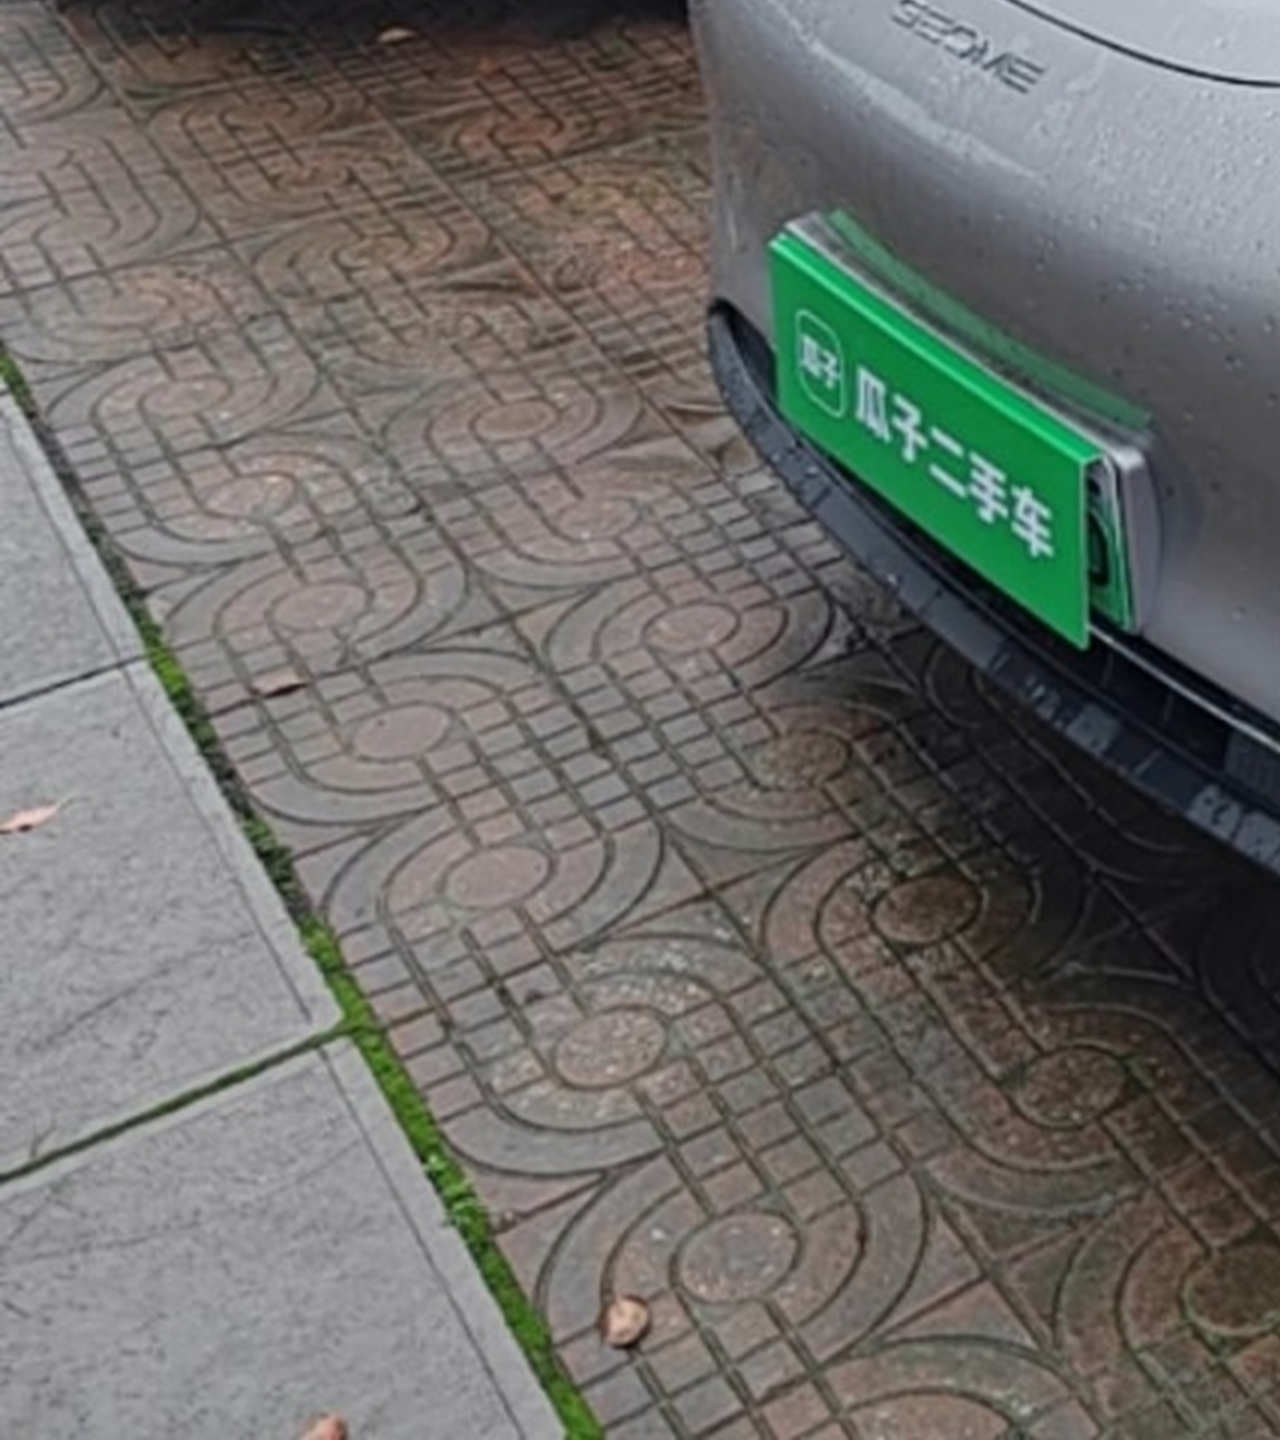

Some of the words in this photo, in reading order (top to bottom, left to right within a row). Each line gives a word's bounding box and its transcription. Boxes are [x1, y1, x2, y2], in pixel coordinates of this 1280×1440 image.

[855, 365, 1055, 557] 瓜子二手车
